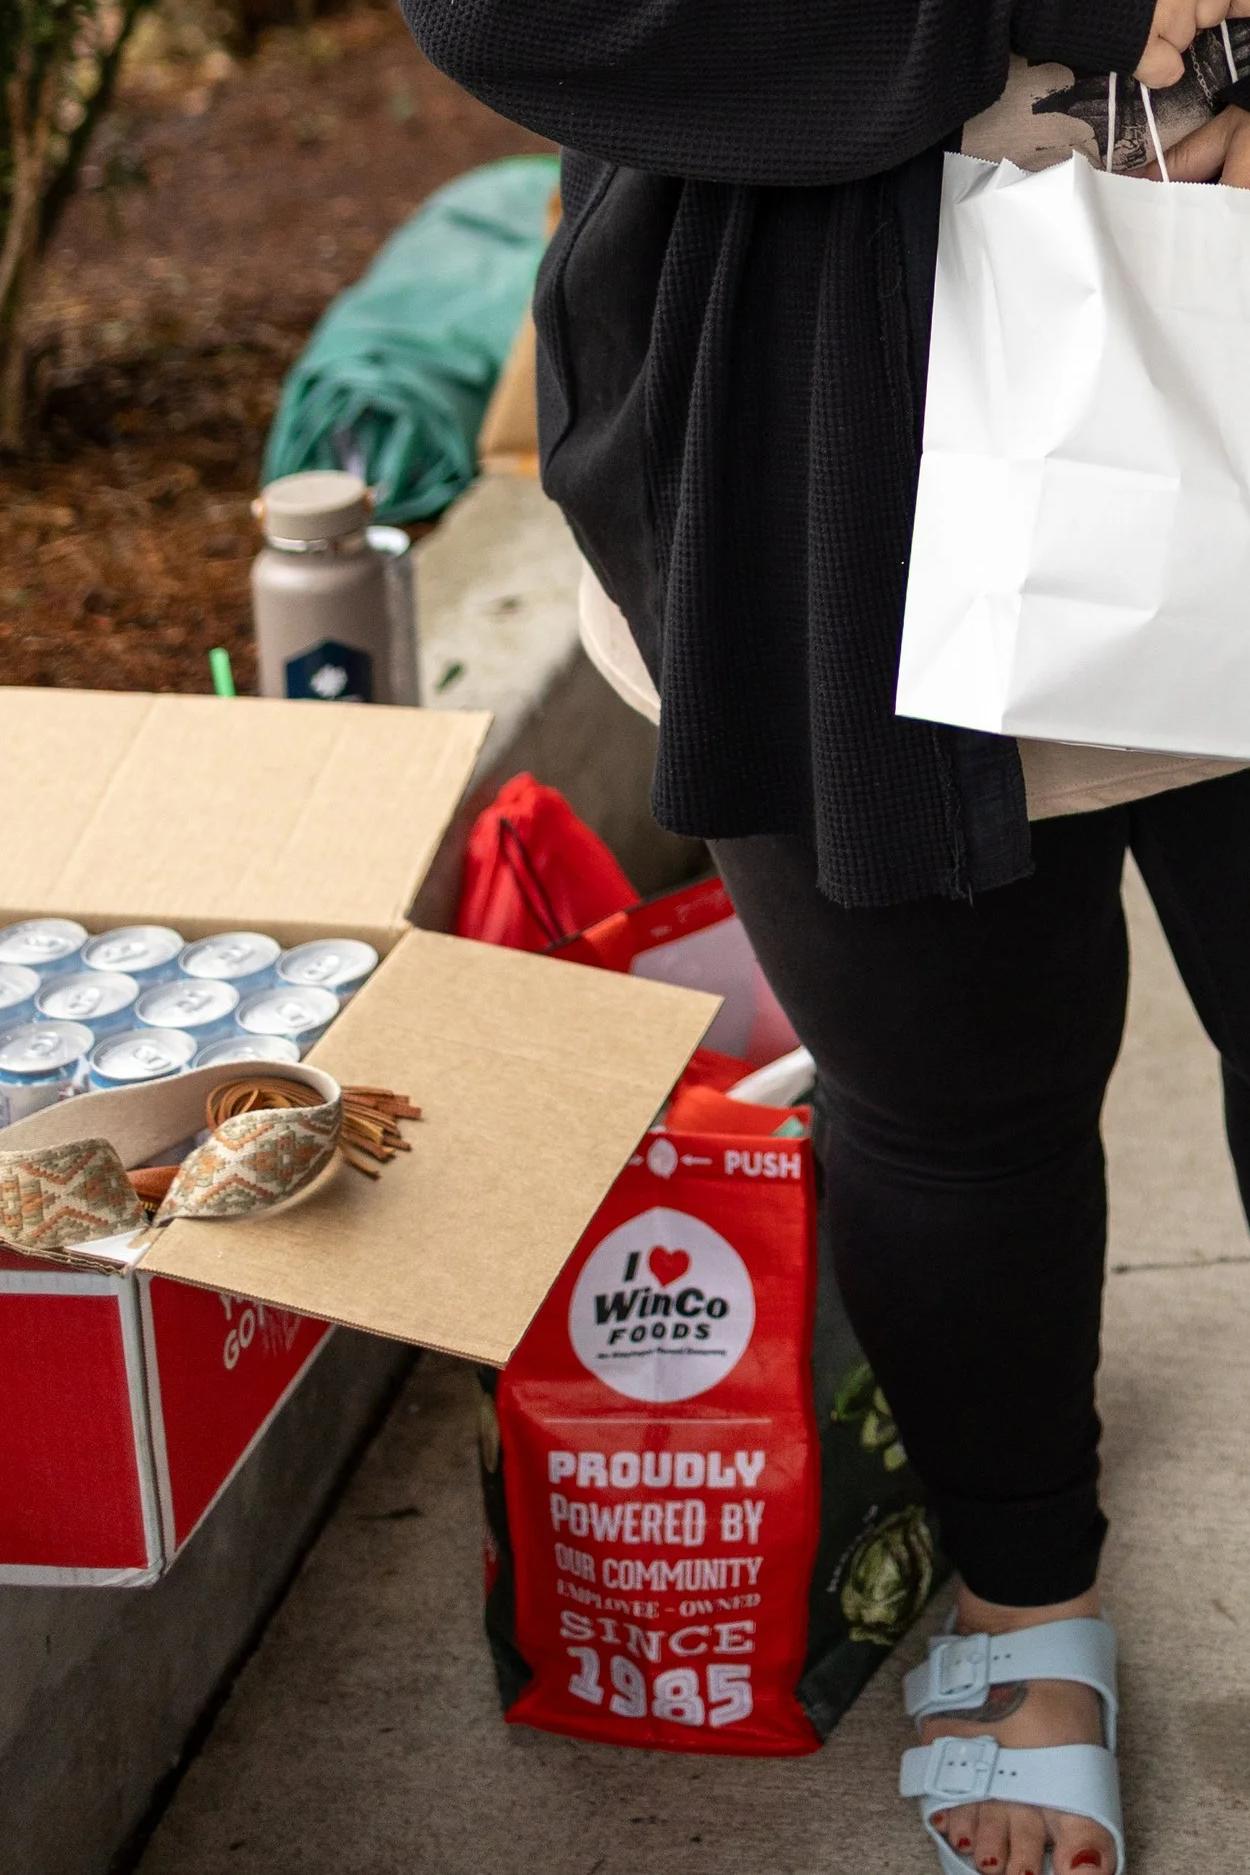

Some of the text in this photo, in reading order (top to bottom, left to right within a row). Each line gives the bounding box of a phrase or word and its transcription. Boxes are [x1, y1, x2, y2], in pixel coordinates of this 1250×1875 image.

[723, 1150, 801, 1179] PUSH
[623, 1251, 642, 1283] I
[594, 1286, 729, 1325] WinCo
[607, 1322, 711, 1345] FOODS
[548, 1450, 766, 1489] PROUDLY
[550, 1492, 706, 1547] POWERED
[720, 1499, 766, 1545] BY
[554, 1542, 764, 1592] OUR COMMUNITY
[678, 1592, 762, 1617] OWNED
[559, 1610, 756, 1663] SINCE
[566, 1646, 754, 1728] 1985
